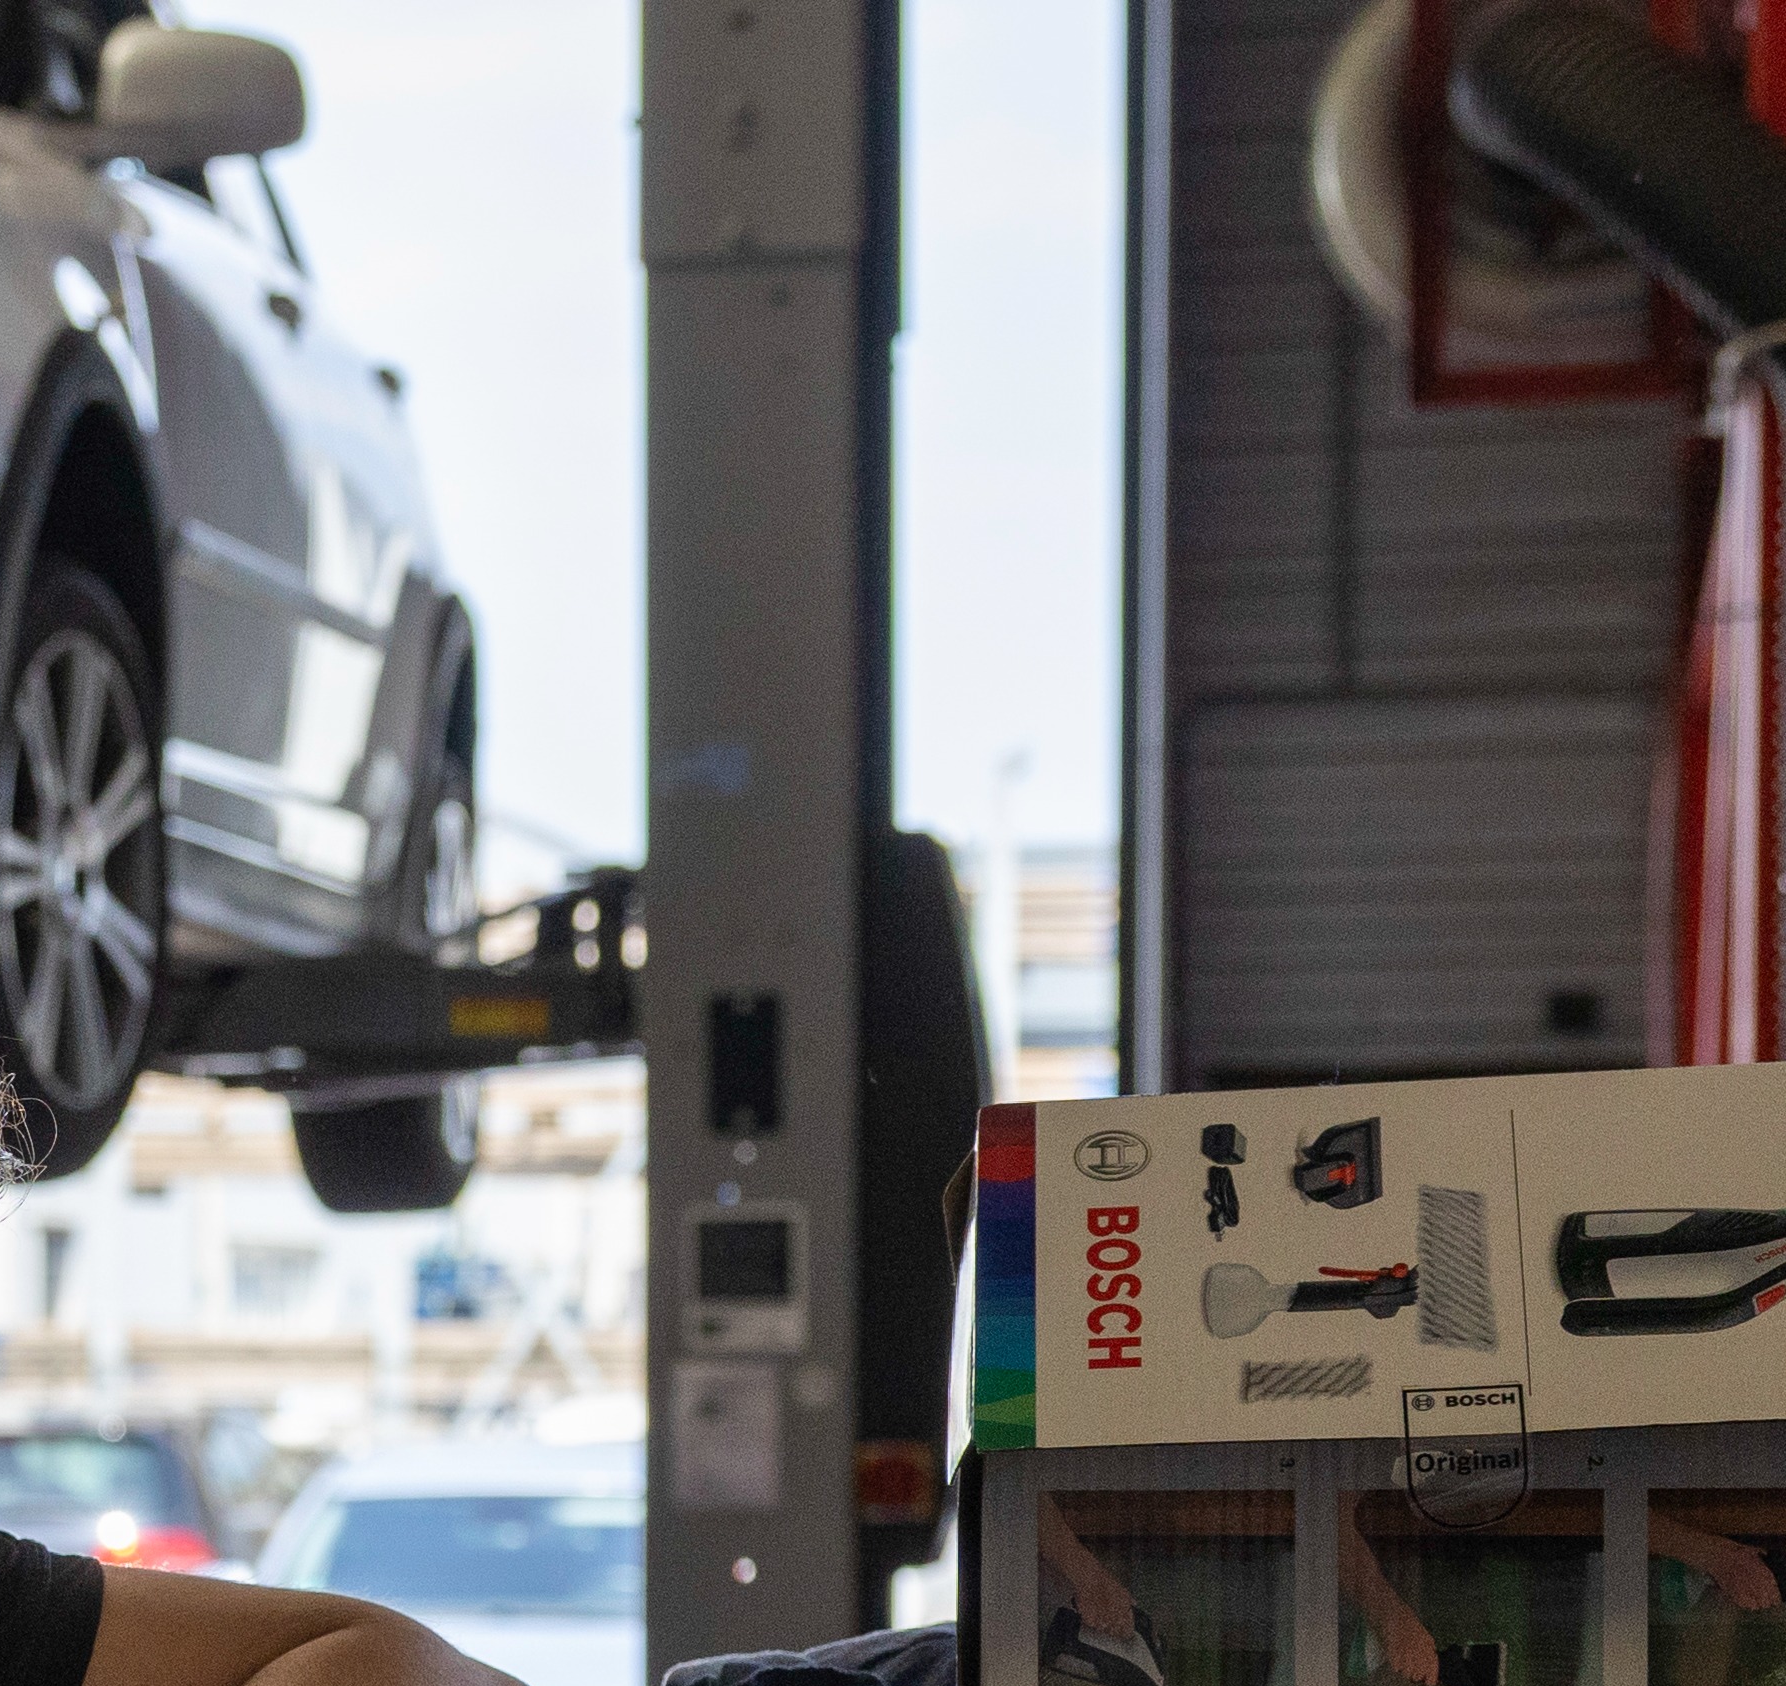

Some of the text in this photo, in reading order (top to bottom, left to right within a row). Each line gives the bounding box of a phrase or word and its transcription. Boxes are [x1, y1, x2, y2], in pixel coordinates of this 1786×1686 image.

[1086, 1206, 1143, 1370] BOSCH
[1445, 1392, 1516, 1408] BOSCH
[1414, 1448, 1520, 1476] Original
